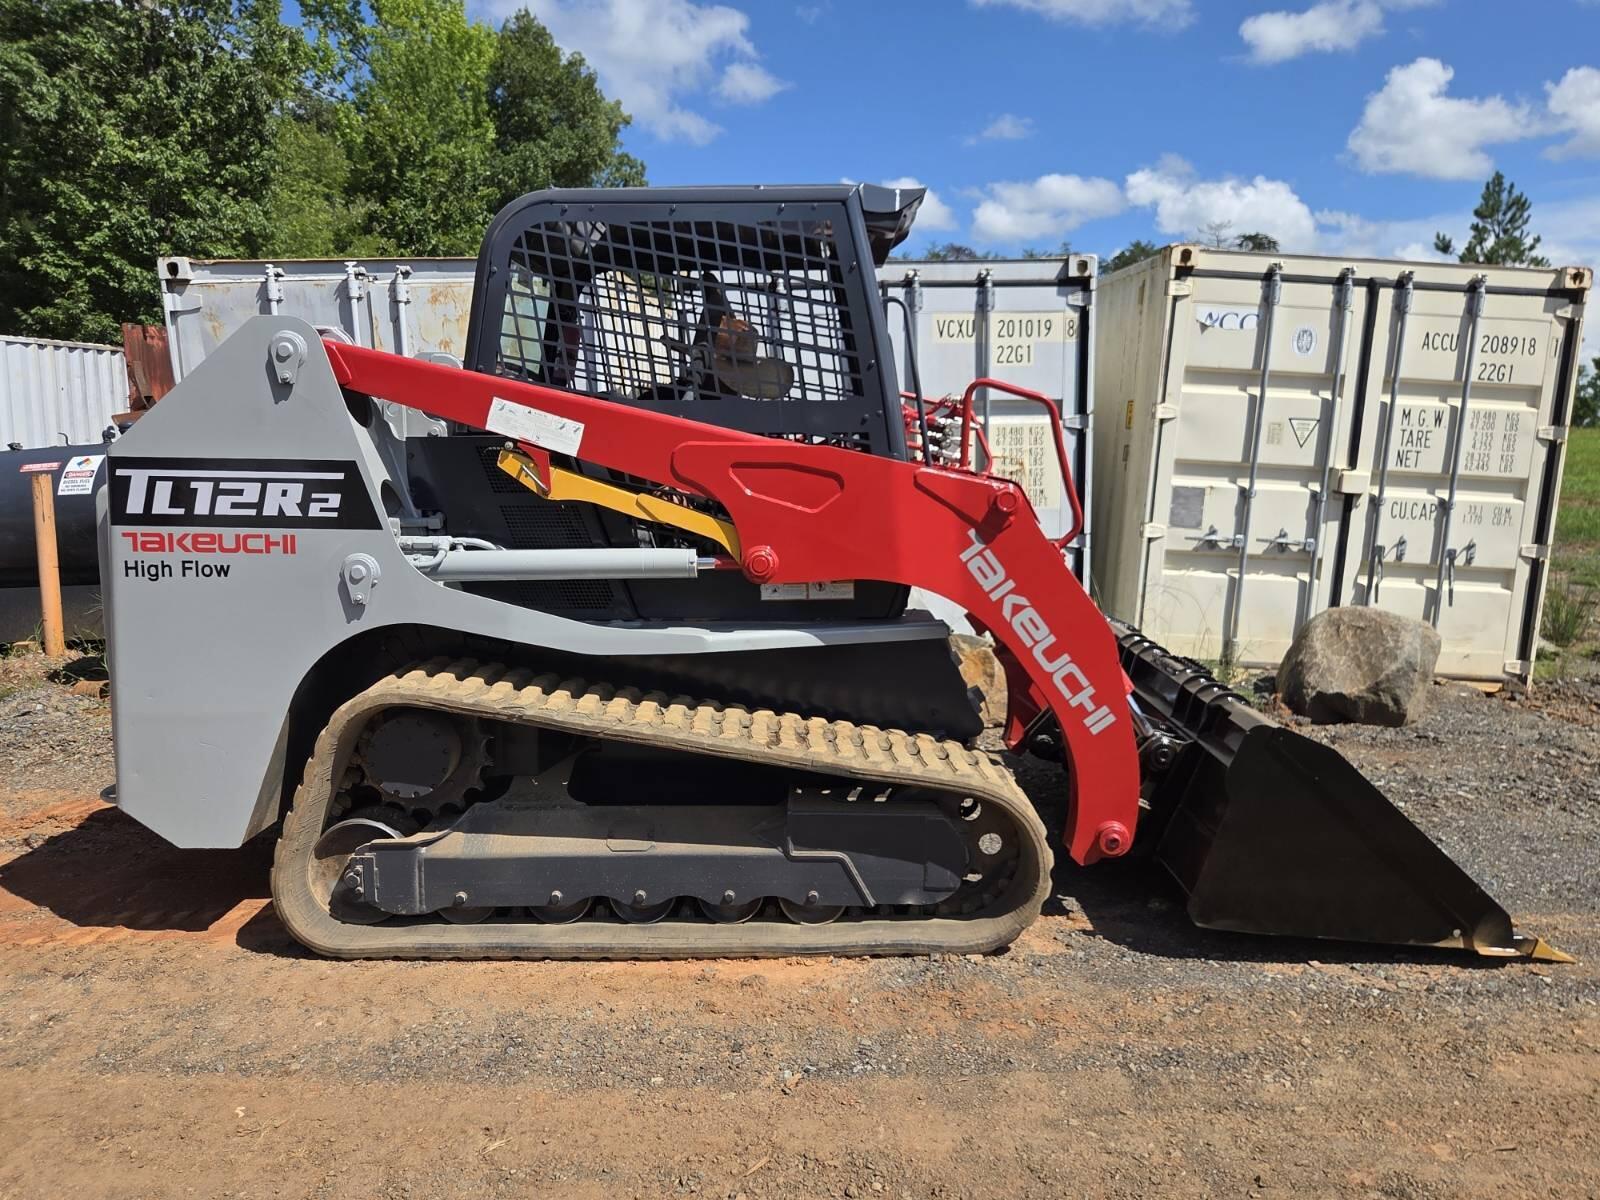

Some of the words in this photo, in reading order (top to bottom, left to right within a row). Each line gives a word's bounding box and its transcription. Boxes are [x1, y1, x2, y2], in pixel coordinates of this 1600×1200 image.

[937, 319, 976, 338] VCXU
[997, 319, 1053, 338] 201019
[1067, 319, 1075, 338] 8
[1422, 331, 1460, 353] ACCU
[1480, 334, 1537, 356] 208918
[996, 345, 1032, 364] 22G1
[1477, 362, 1514, 383] 22G1
[1400, 429, 1432, 449] TARE
[1395, 449, 1421, 469] NET
[121, 531, 297, 555] TAKEUCHI
[124, 560, 173, 581] High
[181, 560, 231, 578] Flow
[959, 528, 1117, 736] TAKEUCHI
